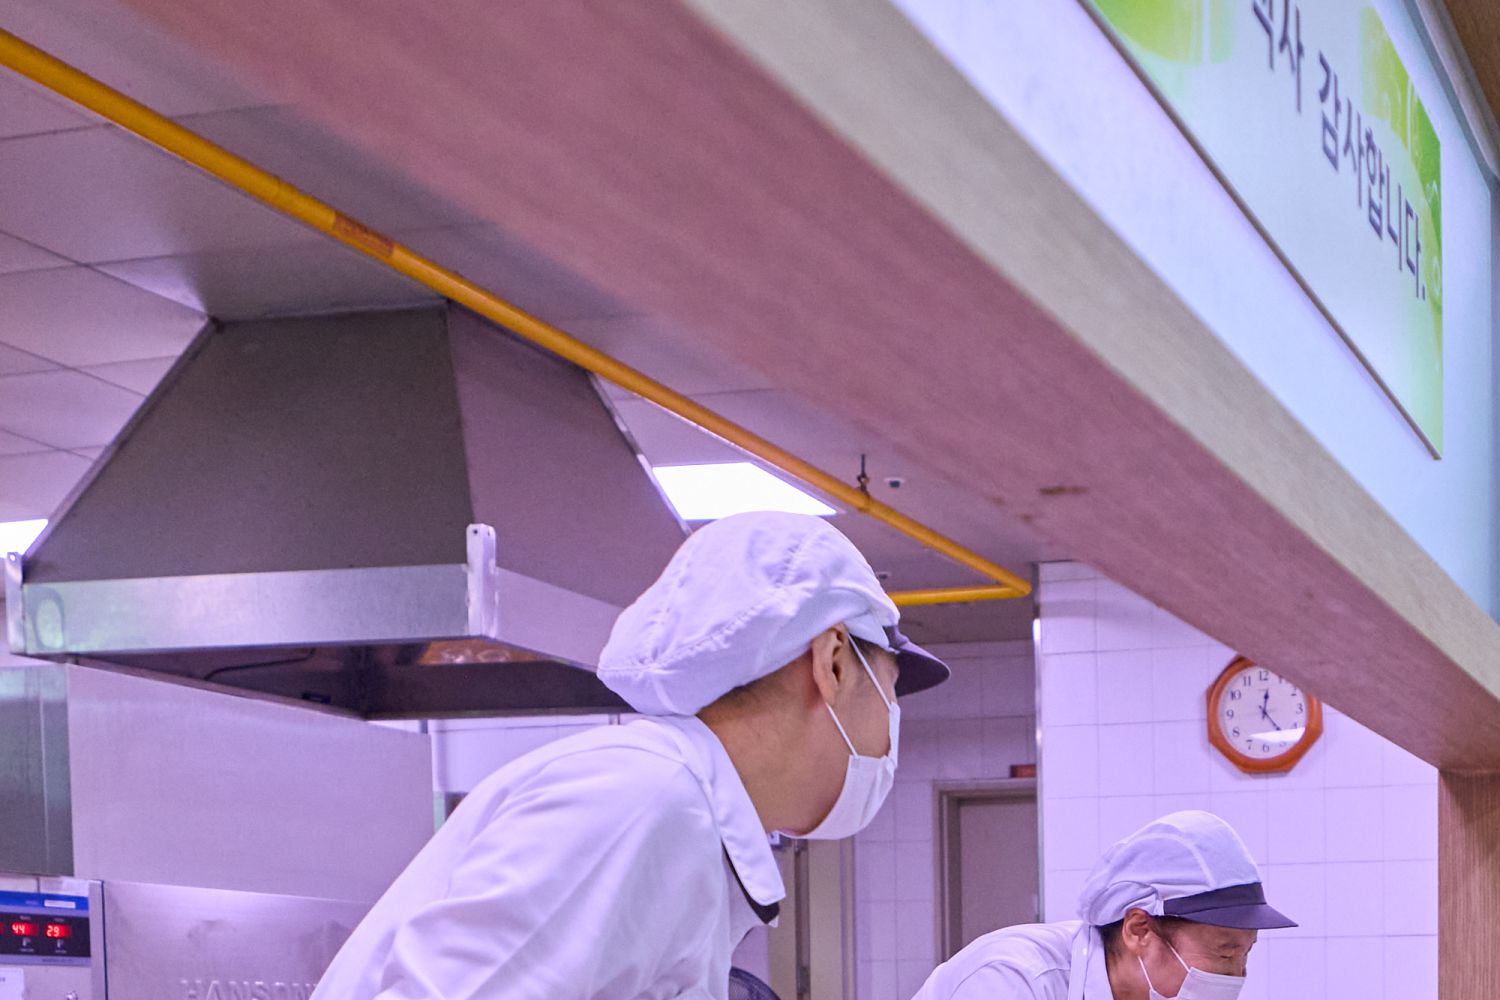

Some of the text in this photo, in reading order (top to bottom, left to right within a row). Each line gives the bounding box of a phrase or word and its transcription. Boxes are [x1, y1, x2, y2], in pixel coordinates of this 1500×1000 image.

[1317, 50, 1426, 301] 감사합니다.
[1243, 675, 1251, 686] 11
[1259, 671, 1269, 681] 12
[1231, 690, 1241, 700] 10
[1226, 709, 1234, 719] 9
[1296, 703, 1303, 714] 3
[1232, 726, 1240, 737] 8
[1246, 739, 1253, 750] 7
[1262, 743, 1270, 753] 6
